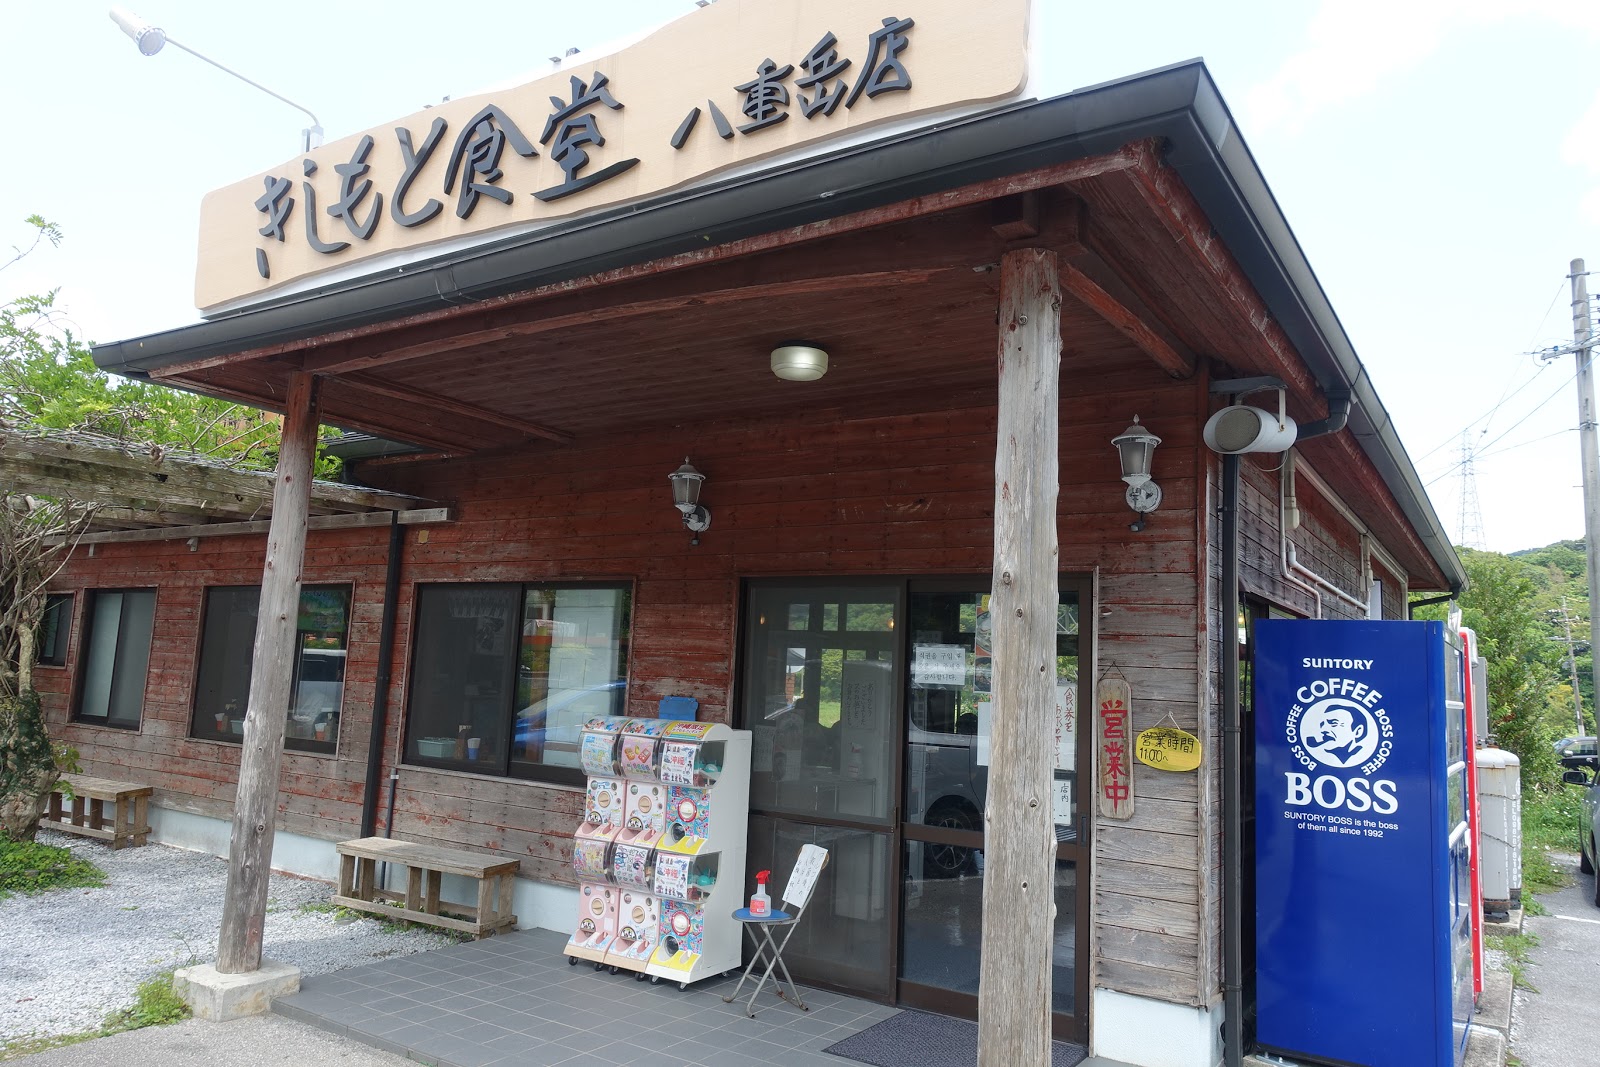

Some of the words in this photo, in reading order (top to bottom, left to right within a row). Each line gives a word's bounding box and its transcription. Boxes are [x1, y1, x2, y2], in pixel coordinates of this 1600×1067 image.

[670, 16, 915, 150] 八重岳店
[1303, 658, 1373, 670] SUNTORY
[1297, 678, 1383, 708] COFFEE
[1064, 687, 1075, 733] 食券を
[1285, 703, 1303, 744] COFFEE
[1374, 708, 1393, 738] BOSS
[1100, 699, 1129, 814] 営業中
[1141, 731, 1194, 754] 営業時間
[1291, 744, 1317, 771] BOSS
[1361, 740, 1393, 776] COFFEE
[1284, 772, 1399, 814] BOSS
[1284, 811, 1326, 822] SUNTORY
[1328, 816, 1353, 825] BOSS
[1363, 819, 1376, 828] the
[1378, 821, 1399, 830] boss
[1298, 821, 1306, 829] of
[1307, 823, 1327, 832] them
[1340, 827, 1361, 835] since
[1363, 829, 1384, 838] 1992
